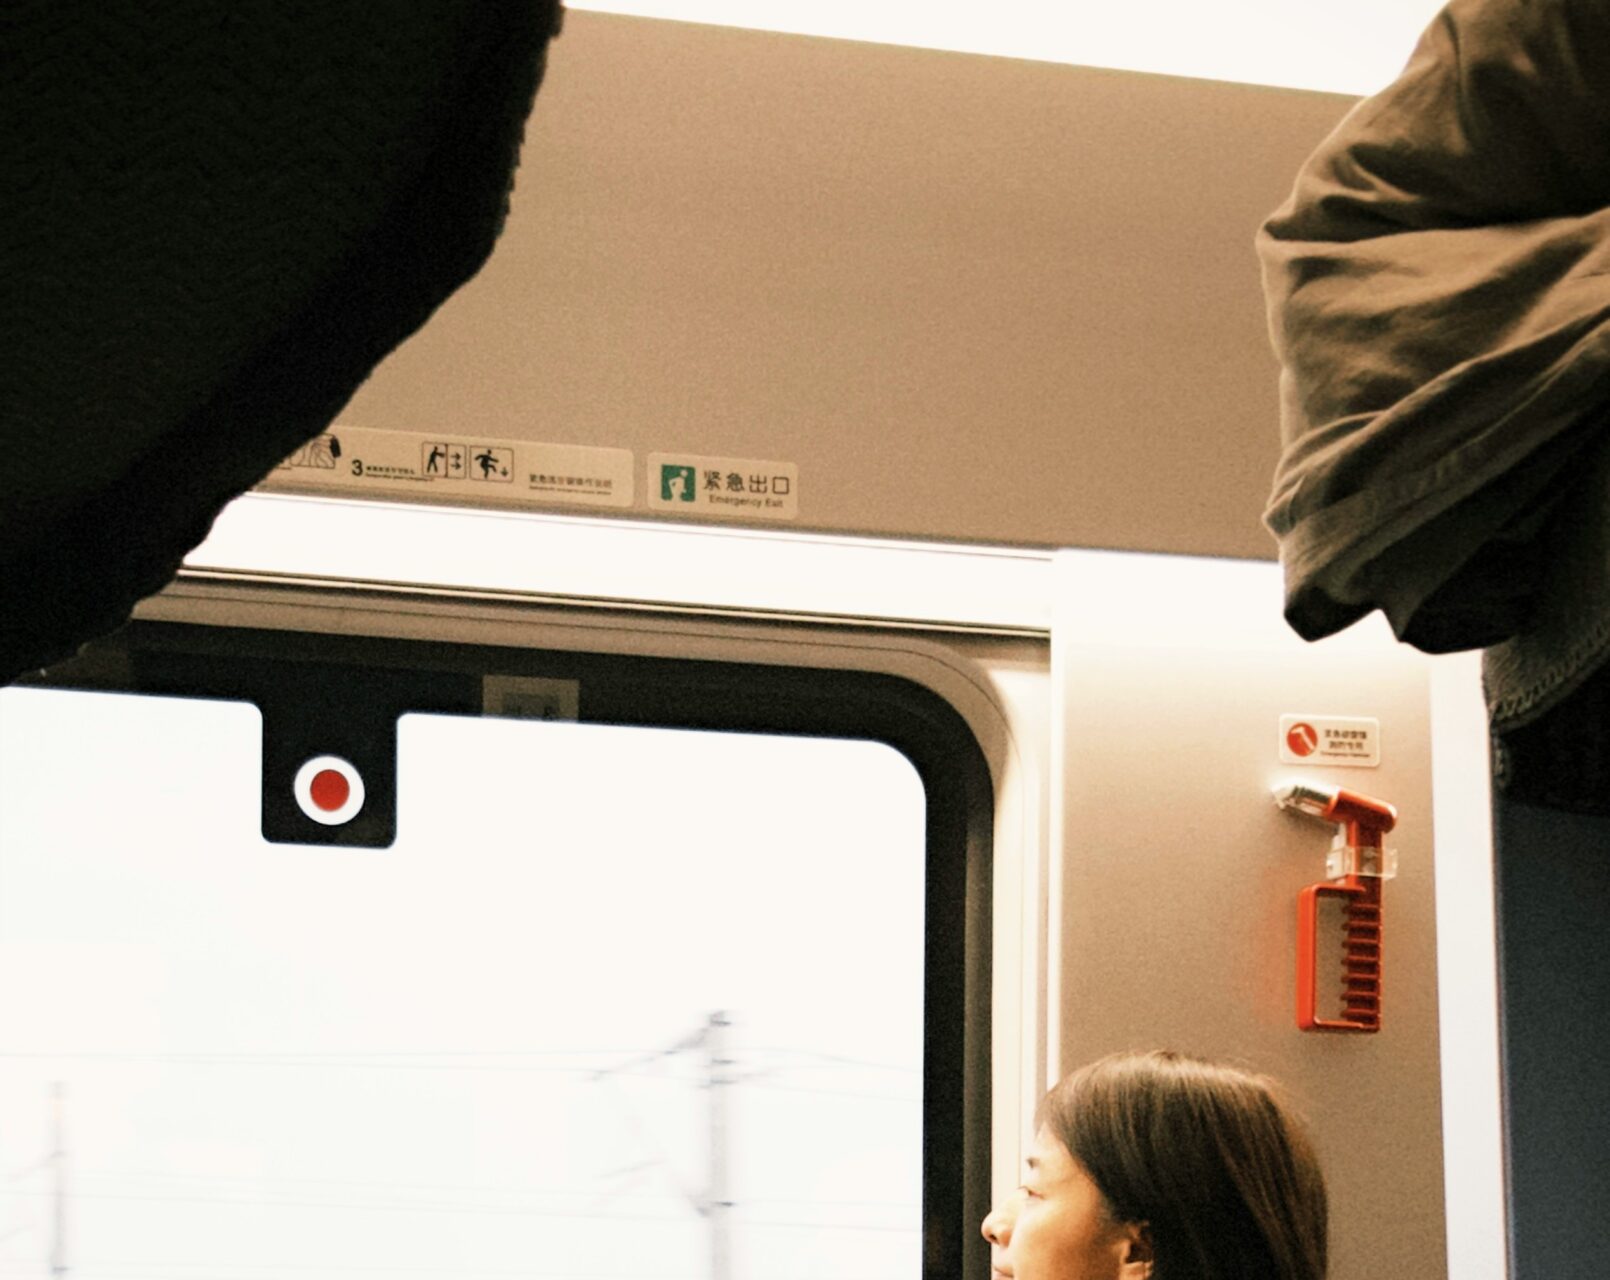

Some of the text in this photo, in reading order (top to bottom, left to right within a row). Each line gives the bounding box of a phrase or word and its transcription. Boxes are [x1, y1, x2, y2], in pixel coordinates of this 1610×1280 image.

[351, 459, 363, 476] 3
[704, 470, 789, 495] 紧急出口
[710, 495, 783, 507] Emergency Exit
